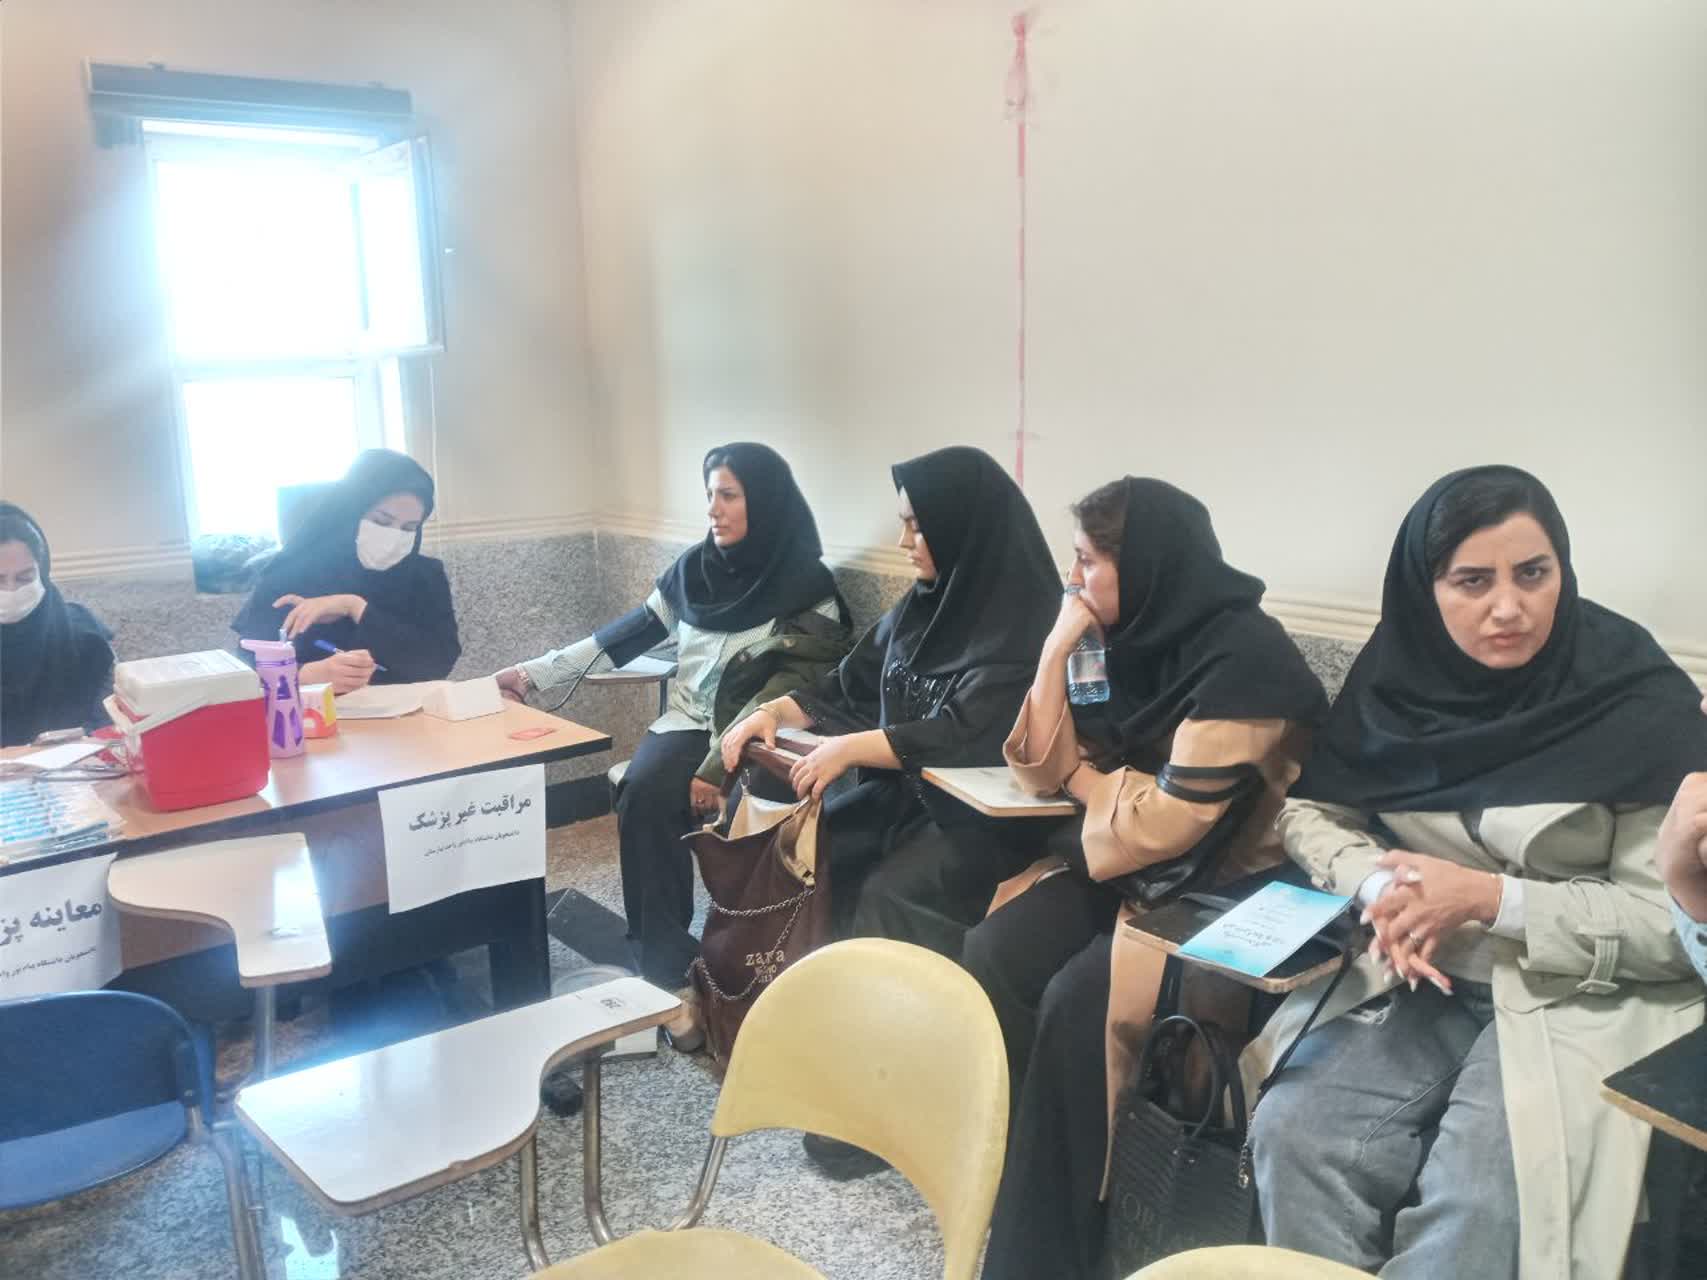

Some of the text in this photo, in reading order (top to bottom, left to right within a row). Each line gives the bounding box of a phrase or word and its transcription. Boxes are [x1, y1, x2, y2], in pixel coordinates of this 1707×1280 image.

[409, 794, 532, 831] مراقبت غیر پزشک
[29, 898, 102, 932] معاینه
